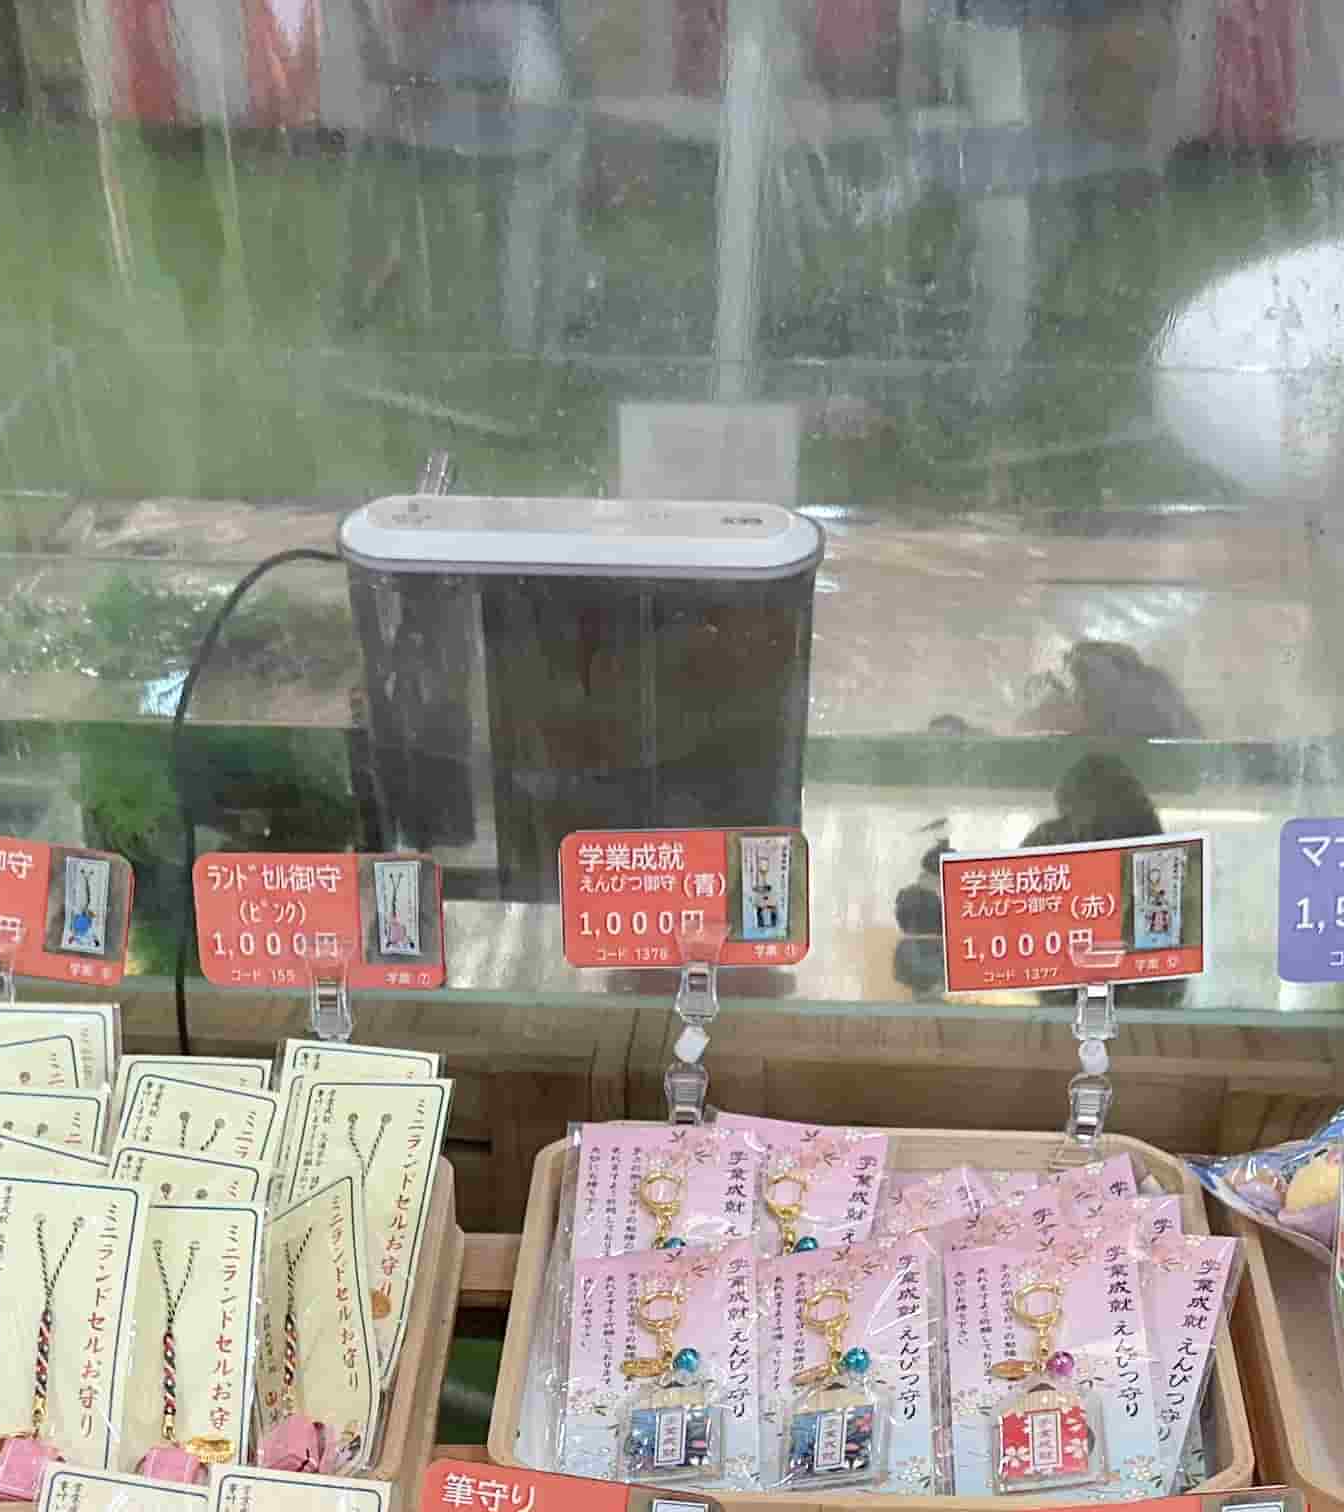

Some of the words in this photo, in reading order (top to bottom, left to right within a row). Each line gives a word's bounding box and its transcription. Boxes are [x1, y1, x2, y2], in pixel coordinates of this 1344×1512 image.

[578, 841, 685, 872] 学業成就
[960, 863, 1072, 897] 学業成就
[579, 910, 704, 940] 1,000円
[212, 931, 337, 959] 1,000円
[962, 928, 1093, 963] 1,000円
[331, 1196, 360, 1390] ミニランドセルお守り
[1106, 1247, 1134, 1313] 学業成就
[79, 1201, 120, 1438] ミニランドセルお守り
